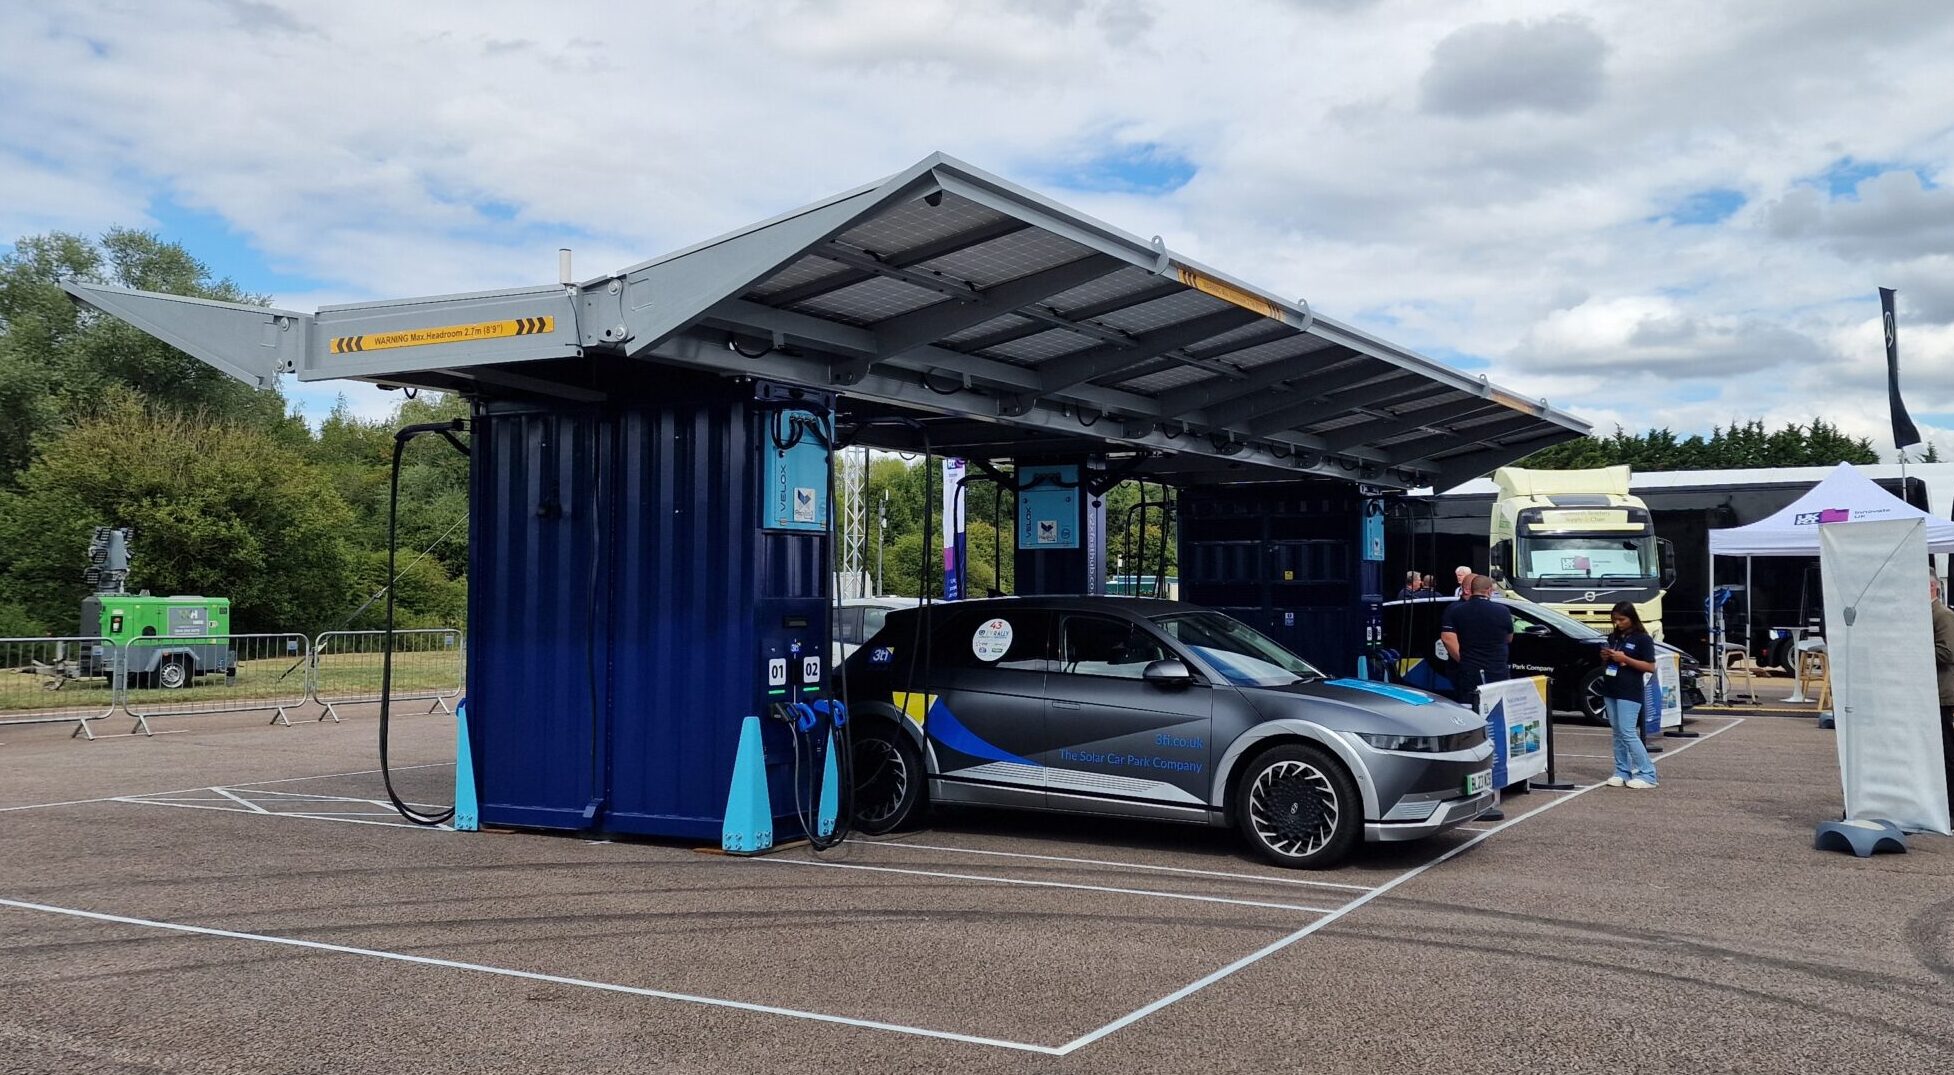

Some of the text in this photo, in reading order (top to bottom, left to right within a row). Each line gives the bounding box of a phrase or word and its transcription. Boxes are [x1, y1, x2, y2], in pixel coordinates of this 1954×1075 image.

[374, 334, 409, 345] WARNING
[426, 330, 462, 340] Headroom
[464, 328, 481, 336] 2.7m
[990, 621, 1002, 629] 43
[771, 665, 783, 678] 01
[806, 663, 818, 676] 02
[1526, 664, 1554, 673] Company
[1059, 748, 1202, 774] The Solar Car Park Company
